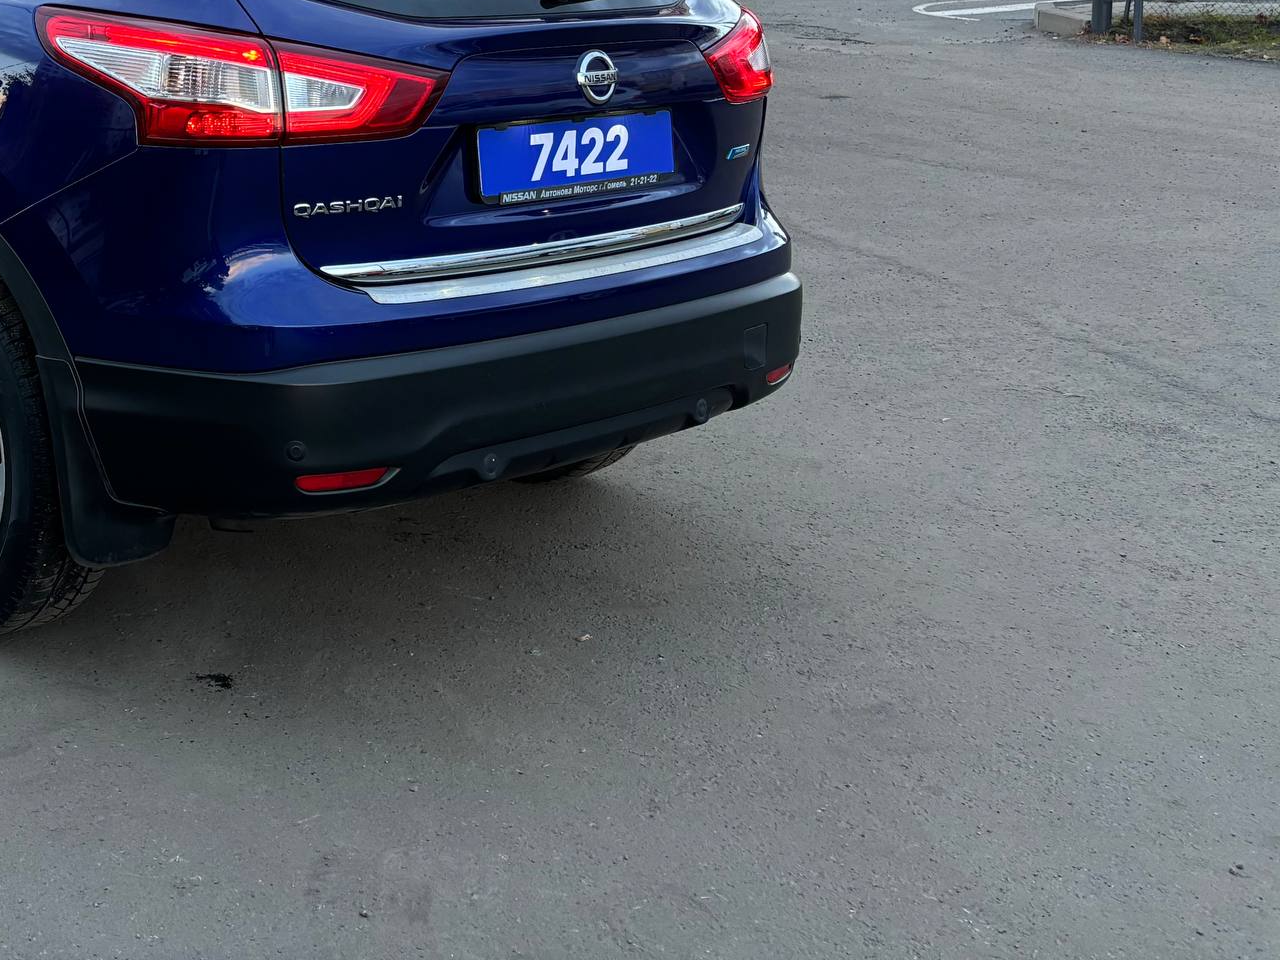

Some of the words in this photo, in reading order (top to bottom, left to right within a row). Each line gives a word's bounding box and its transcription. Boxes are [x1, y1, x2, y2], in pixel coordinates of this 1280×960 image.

[584, 73, 616, 83] NISSAN
[530, 124, 629, 182] 7422
[502, 190, 537, 204] NISSAN
[540, 187, 572, 199] Автонова
[573, 184, 598, 194] Моторс
[630, 174, 657, 186] 21-21-22
[293, 195, 403, 219] QASHQAI
